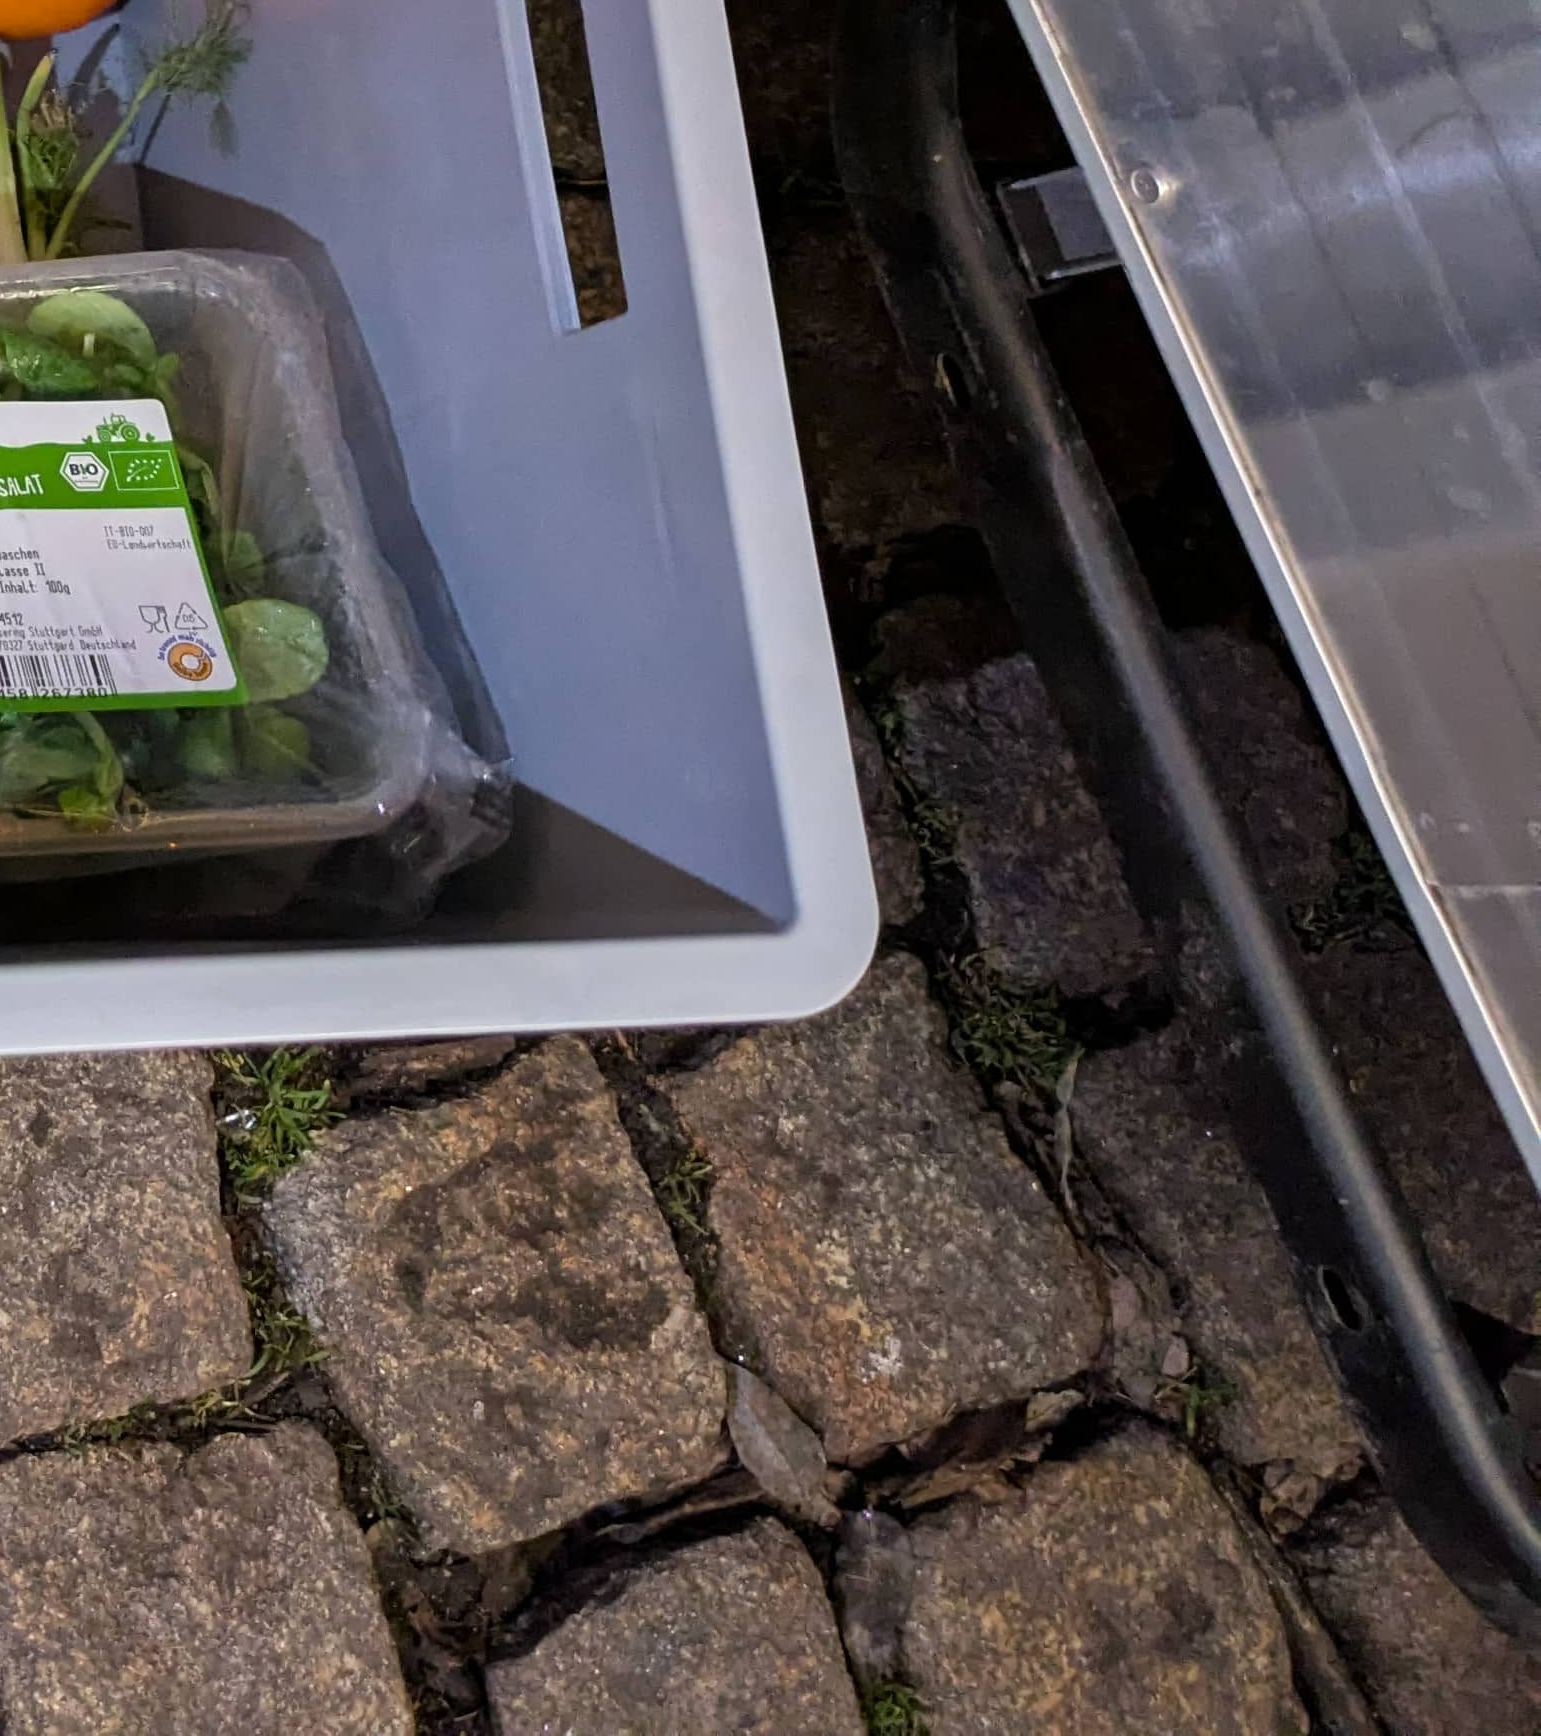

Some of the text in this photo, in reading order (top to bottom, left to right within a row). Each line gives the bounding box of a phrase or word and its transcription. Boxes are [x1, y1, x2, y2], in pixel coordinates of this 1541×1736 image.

[68, 463, 99, 476] BIO
[34, 563, 46, 576] II
[0, 580, 71, 595] Inhalt: 100g
